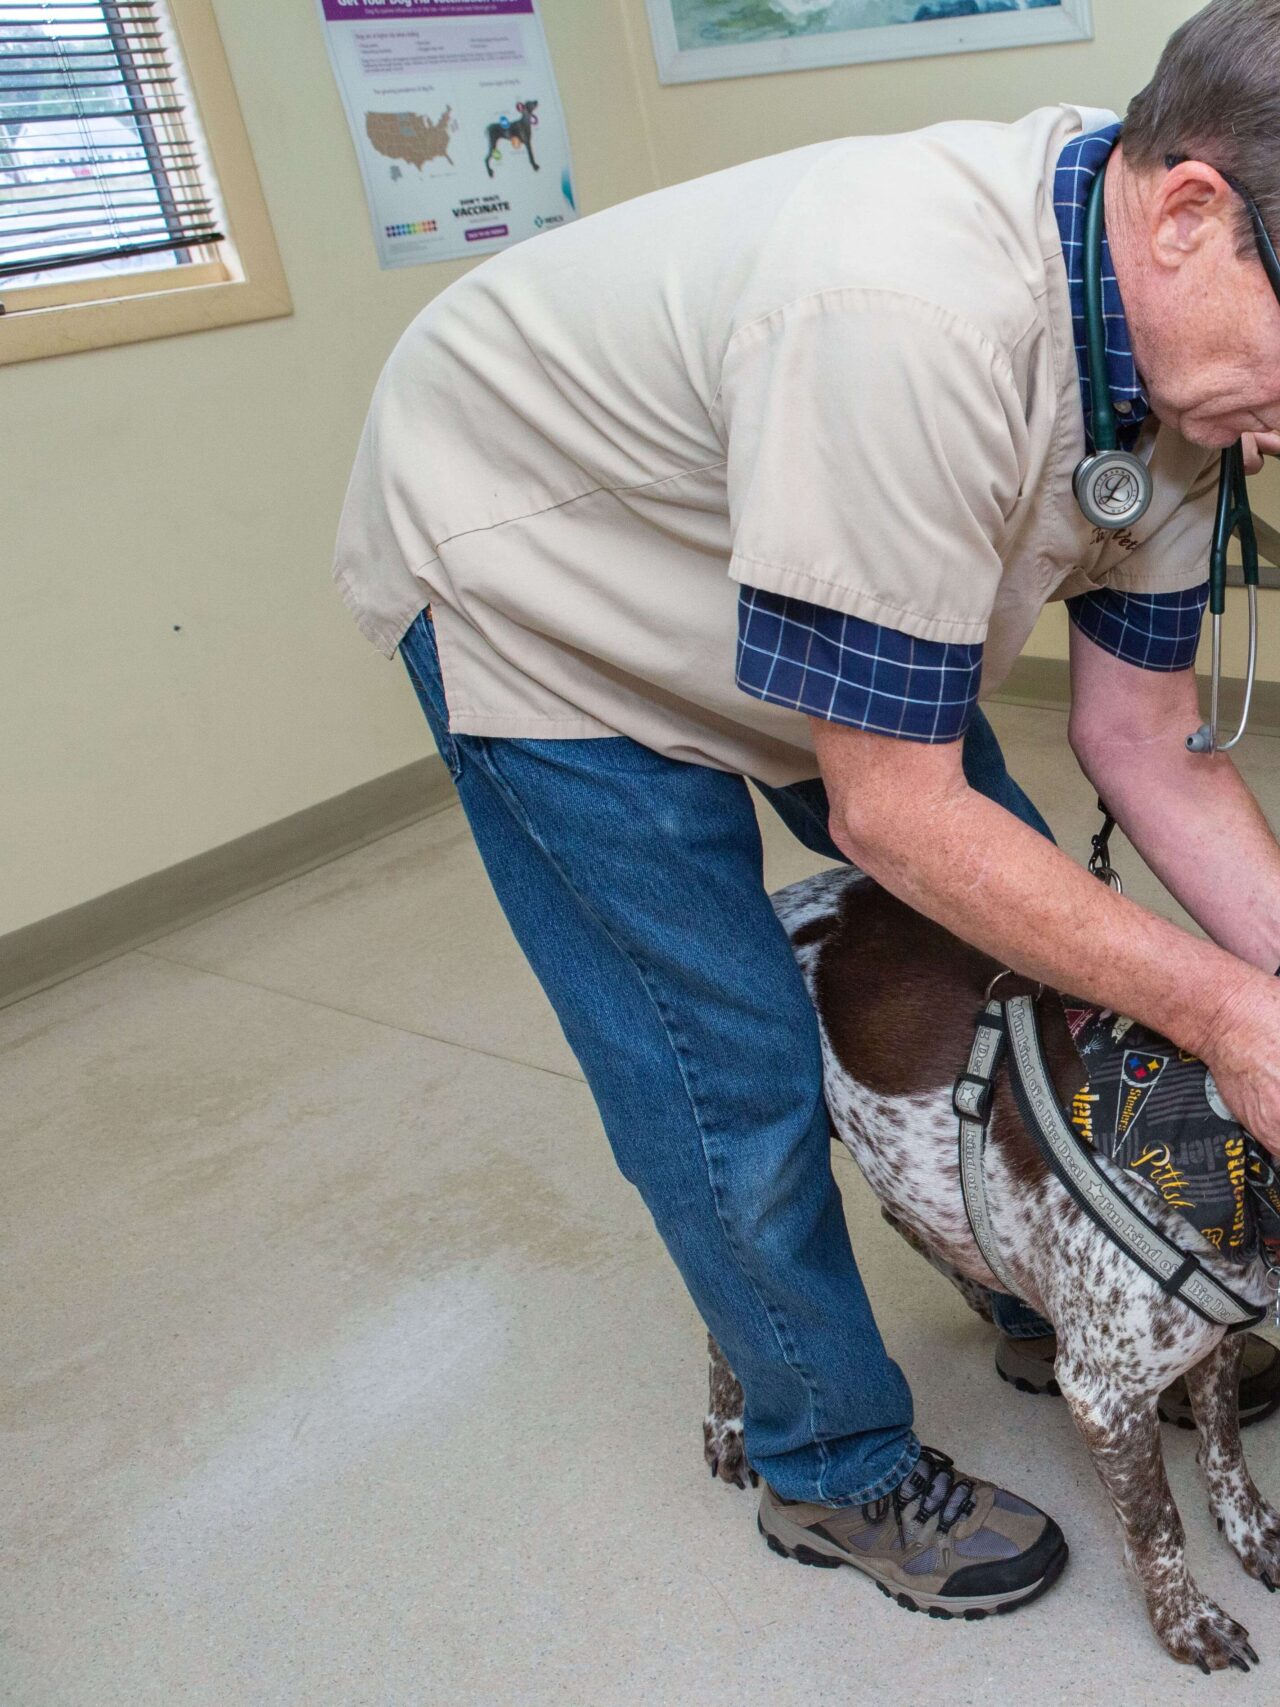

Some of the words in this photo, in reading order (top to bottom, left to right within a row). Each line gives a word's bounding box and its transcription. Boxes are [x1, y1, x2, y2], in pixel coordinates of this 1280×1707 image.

[452, 201, 510, 217] VACCINATE
[1012, 1008, 1025, 1037] I'm
[973, 1043, 991, 1075] Dea
[1018, 1036, 1035, 1078] kind
[1029, 1079, 1043, 1099] of
[1035, 1101, 1045, 1112] a
[1117, 1088, 1142, 1132] Steelers
[1042, 1111, 1061, 1144] Big
[966, 1129, 977, 1170] kind
[1058, 1141, 1088, 1181] Deal
[1101, 1198, 1124, 1227] I'm
[1123, 1224, 1160, 1262] kind
[1159, 1258, 1179, 1277] of
[1188, 1280, 1213, 1307] Big
